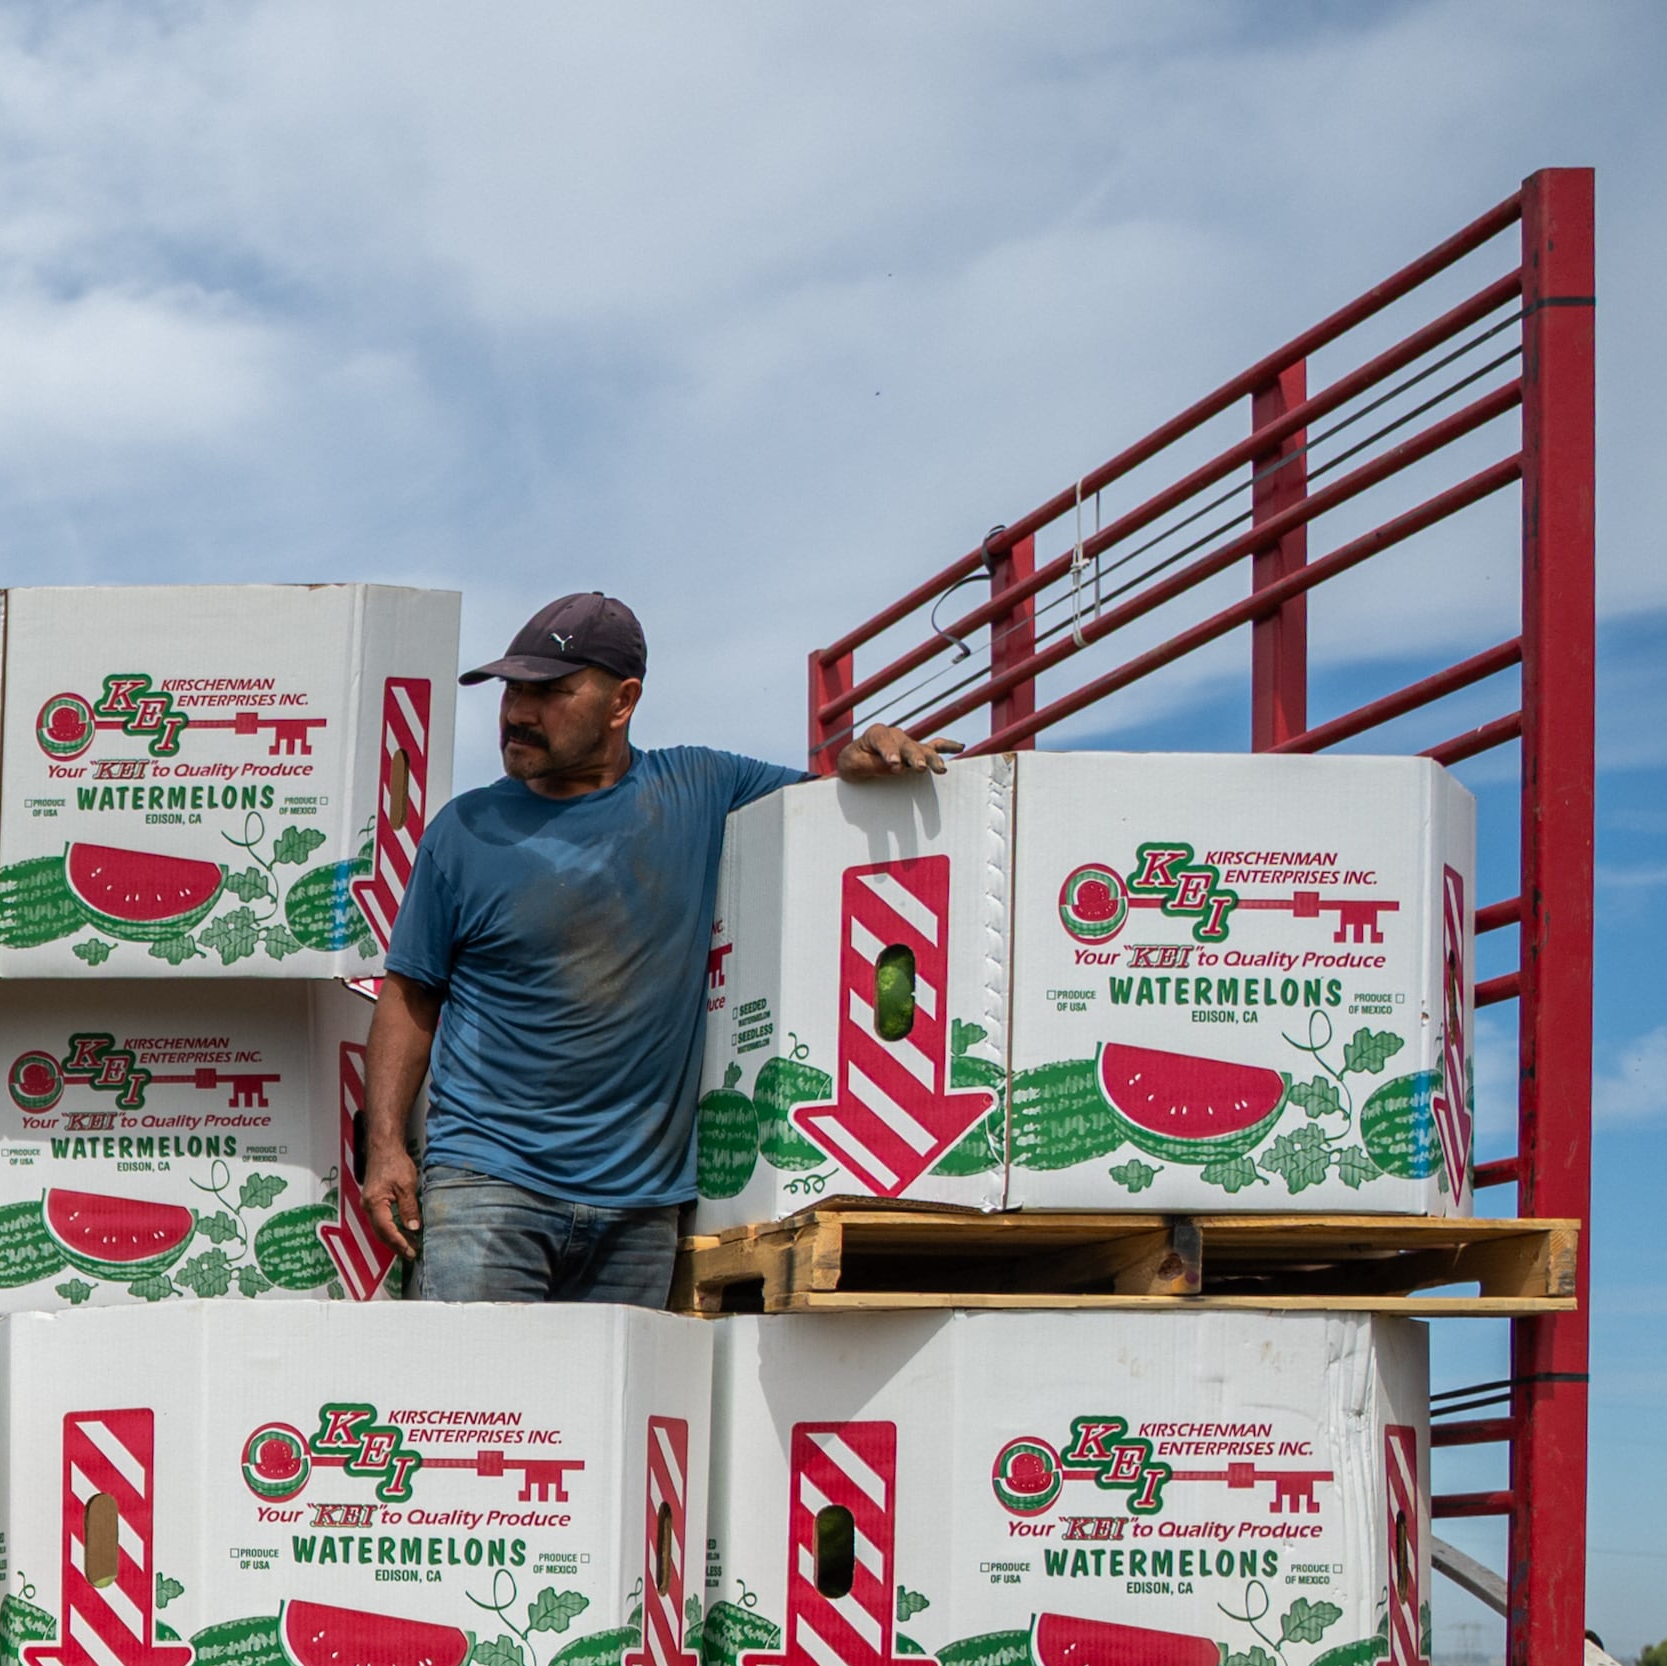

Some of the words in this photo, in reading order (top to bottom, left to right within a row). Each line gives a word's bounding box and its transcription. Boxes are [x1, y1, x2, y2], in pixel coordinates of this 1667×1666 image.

[161, 677, 275, 692] KIRSCHENMAN
[177, 693, 275, 708] ENTERPRISES
[279, 694, 309, 706] INC.
[97, 676, 185, 755] KEI
[76, 783, 275, 813] WATERMELONS
[1205, 851, 1338, 866] KIRSCHENMAN
[1225, 869, 1339, 886] ENTERPRISES
[1343, 871, 1378, 886] INC.
[1131, 847, 1234, 939] KEI
[1073, 949, 1120, 966] Your
[1199, 951, 1218, 966] to
[1223, 951, 1300, 972] Quality
[1302, 951, 1387, 968] Produce
[1057, 990, 1096, 1000] PRODUCE
[1108, 976, 1343, 1007] WATERMELONS
[1354, 993, 1393, 1003] PRODUCE
[739, 998, 767, 1016] SEEDED
[1056, 1002, 1070, 1012] OF
[1072, 1002, 1088, 1012] USA
[1348, 1005, 1361, 1015] OF
[1362, 1005, 1392, 1015] MEXICO
[1191, 1010, 1239, 1024] EDISON,
[1242, 1010, 1259, 1023] CA
[737, 1022, 773, 1044] SEEDLESS
[123, 1037, 230, 1050] KIRSCHENMAN
[140, 1051, 231, 1065] ENTERPRISES
[234, 1052, 263, 1063] INC.
[66, 1036, 147, 1108] KEI
[21, 1116, 59, 1130] Your
[122, 1116, 137, 1128] to
[141, 1114, 202, 1132] Quality
[204, 1113, 272, 1128] Produce
[50, 1133, 237, 1161] WATERMELONS
[388, 1410, 522, 1426] KIRSCHENMAN
[408, 1428, 523, 1445] ENTERPRISES
[527, 1431, 563, 1445] INC.
[1139, 1422, 1272, 1438] KIRSCHENMAN
[314, 1407, 417, 1498] KEI
[1159, 1440, 1273, 1457] ENTERPRISES
[1277, 1442, 1314, 1456] INC.
[1065, 1420, 1168, 1511] KEI
[1007, 1521, 1054, 1538] Your
[1134, 1522, 1153, 1537] to
[1158, 1522, 1236, 1543] Quality
[1238, 1521, 1323, 1539] Produce
[291, 1535, 527, 1567] WATERMELONS
[1042, 1547, 1279, 1579] WATERMELONS
[374, 1569, 423, 1583] EDISON,
[426, 1569, 443, 1582] CA
